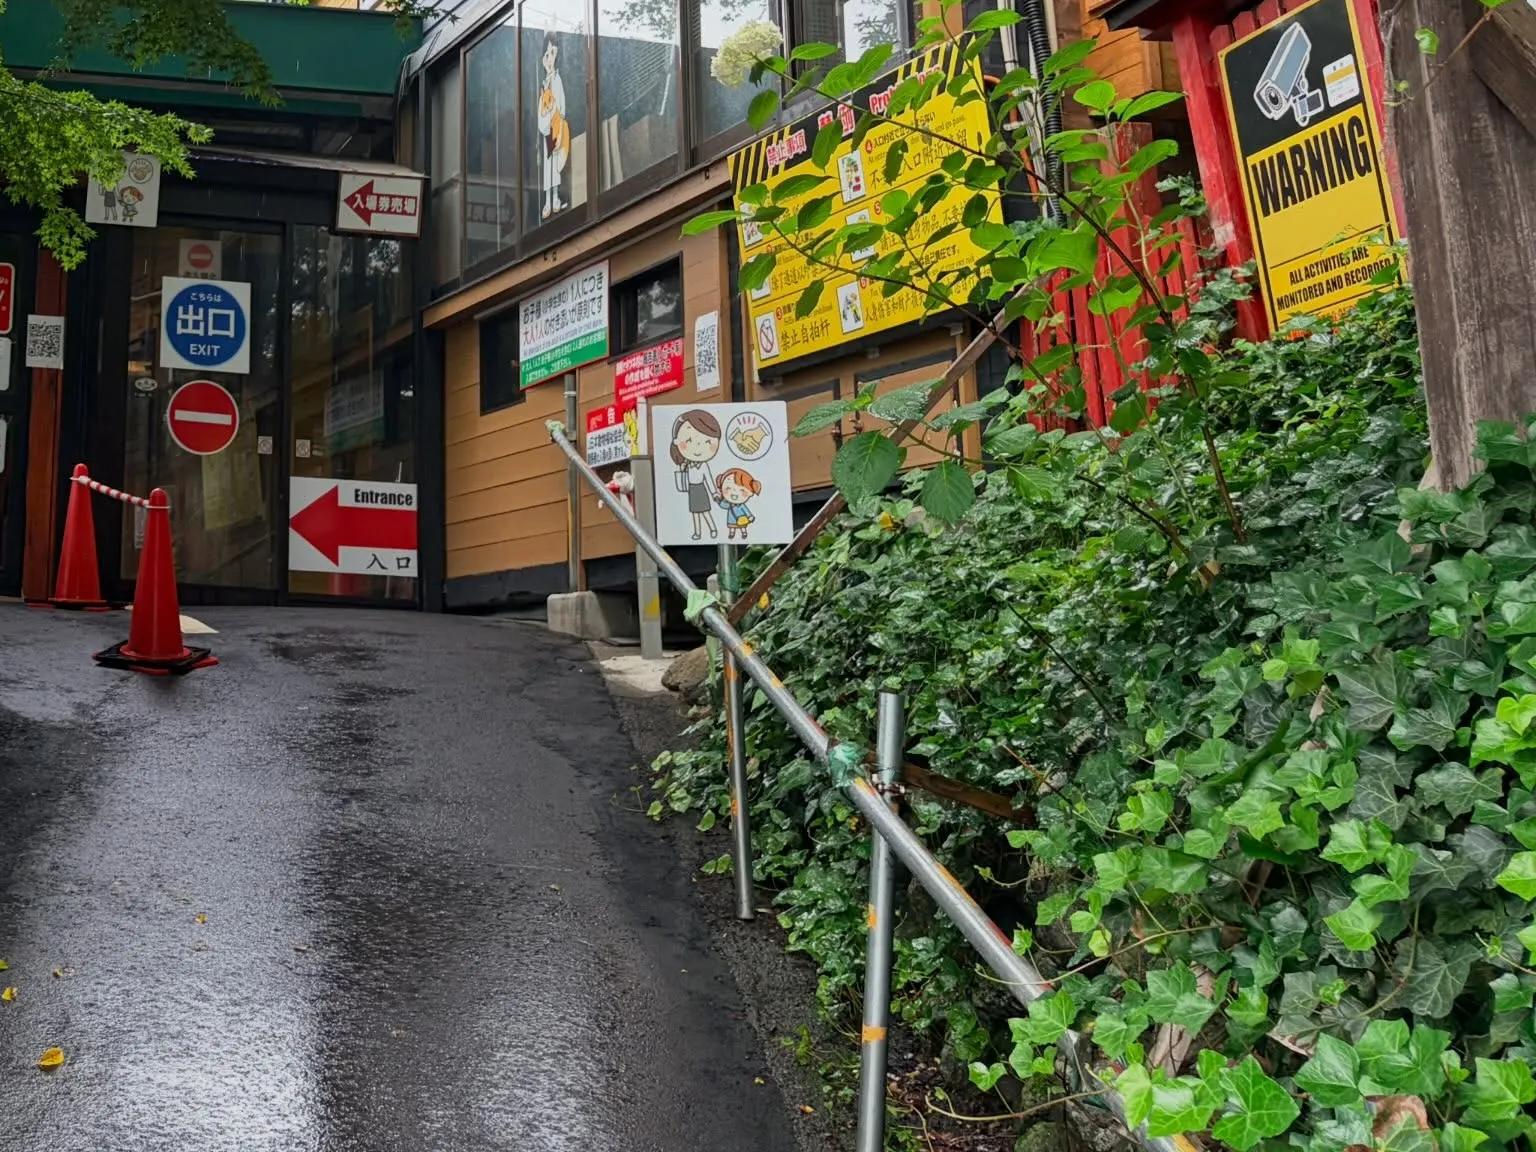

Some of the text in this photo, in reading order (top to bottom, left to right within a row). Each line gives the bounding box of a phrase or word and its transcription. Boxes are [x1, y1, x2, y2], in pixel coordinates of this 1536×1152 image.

[1251, 115, 1372, 219] WARNING
[1289, 246, 1370, 286] ALL ACTIVITIES ARE
[190, 292, 223, 303] こちらは
[1276, 280, 1325, 311] MONITORED
[1325, 274, 1344, 293] AND
[176, 303, 235, 339] 出口
[189, 343, 221, 356] EXIT
[354, 488, 414, 506] Entrance
[366, 552, 412, 570] 入口
